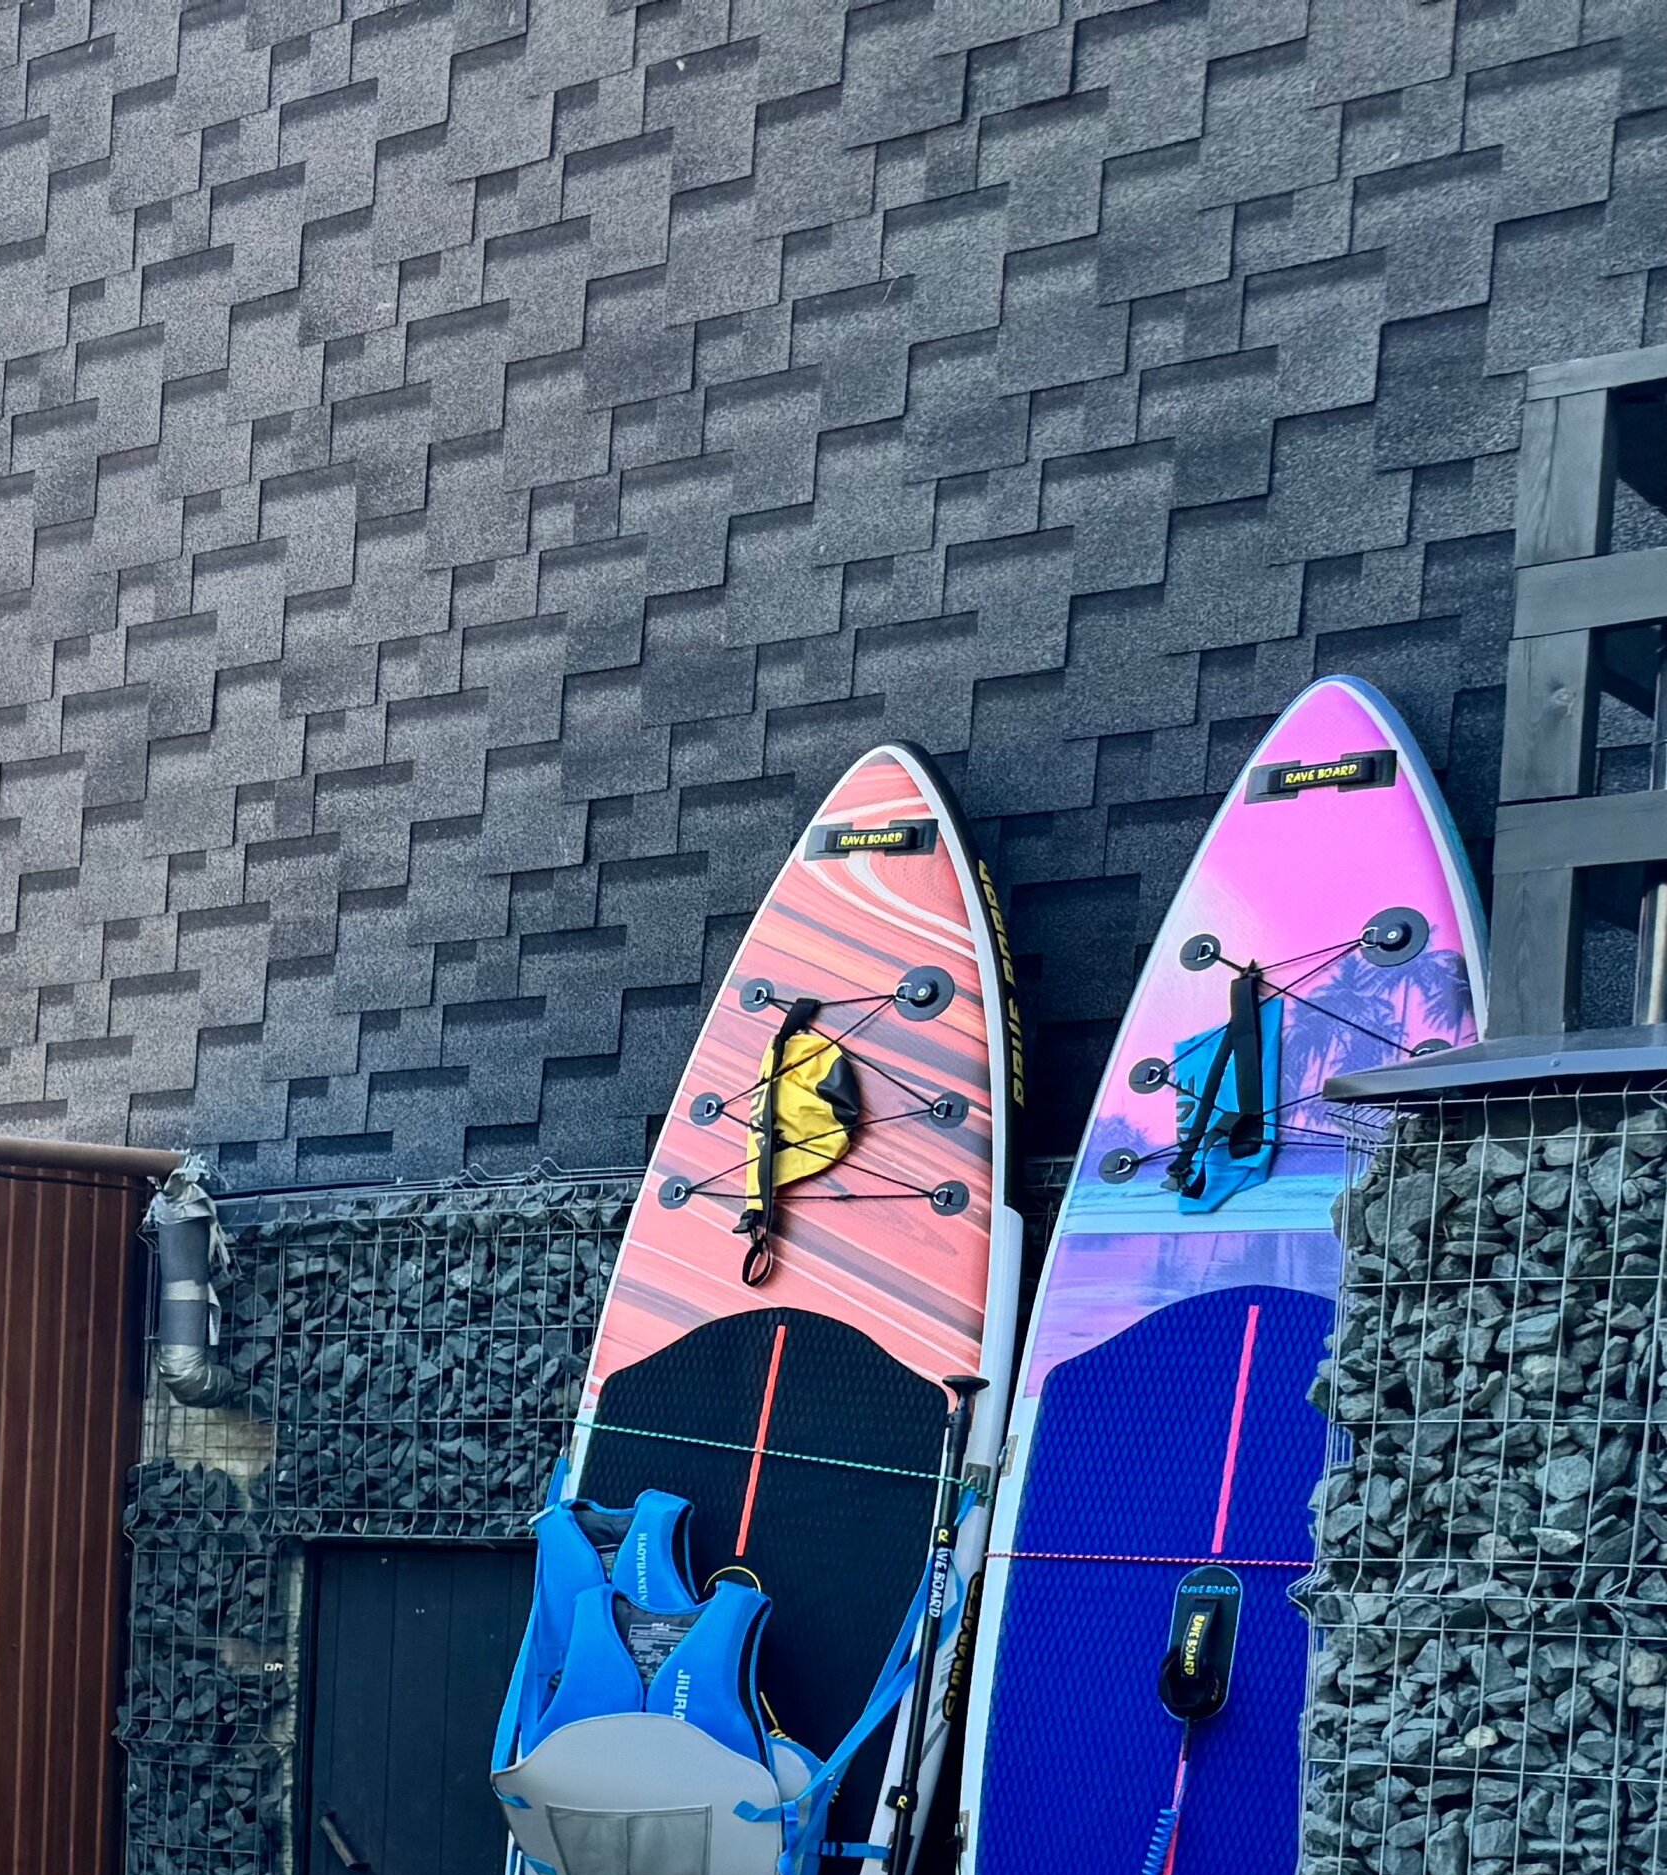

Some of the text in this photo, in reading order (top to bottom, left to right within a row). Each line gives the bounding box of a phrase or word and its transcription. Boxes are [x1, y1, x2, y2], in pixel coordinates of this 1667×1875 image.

[1285, 763, 1358, 785] RAVE BOARD
[840, 831, 904, 847] RAVE BOARD
[937, 1528, 950, 1543] R
